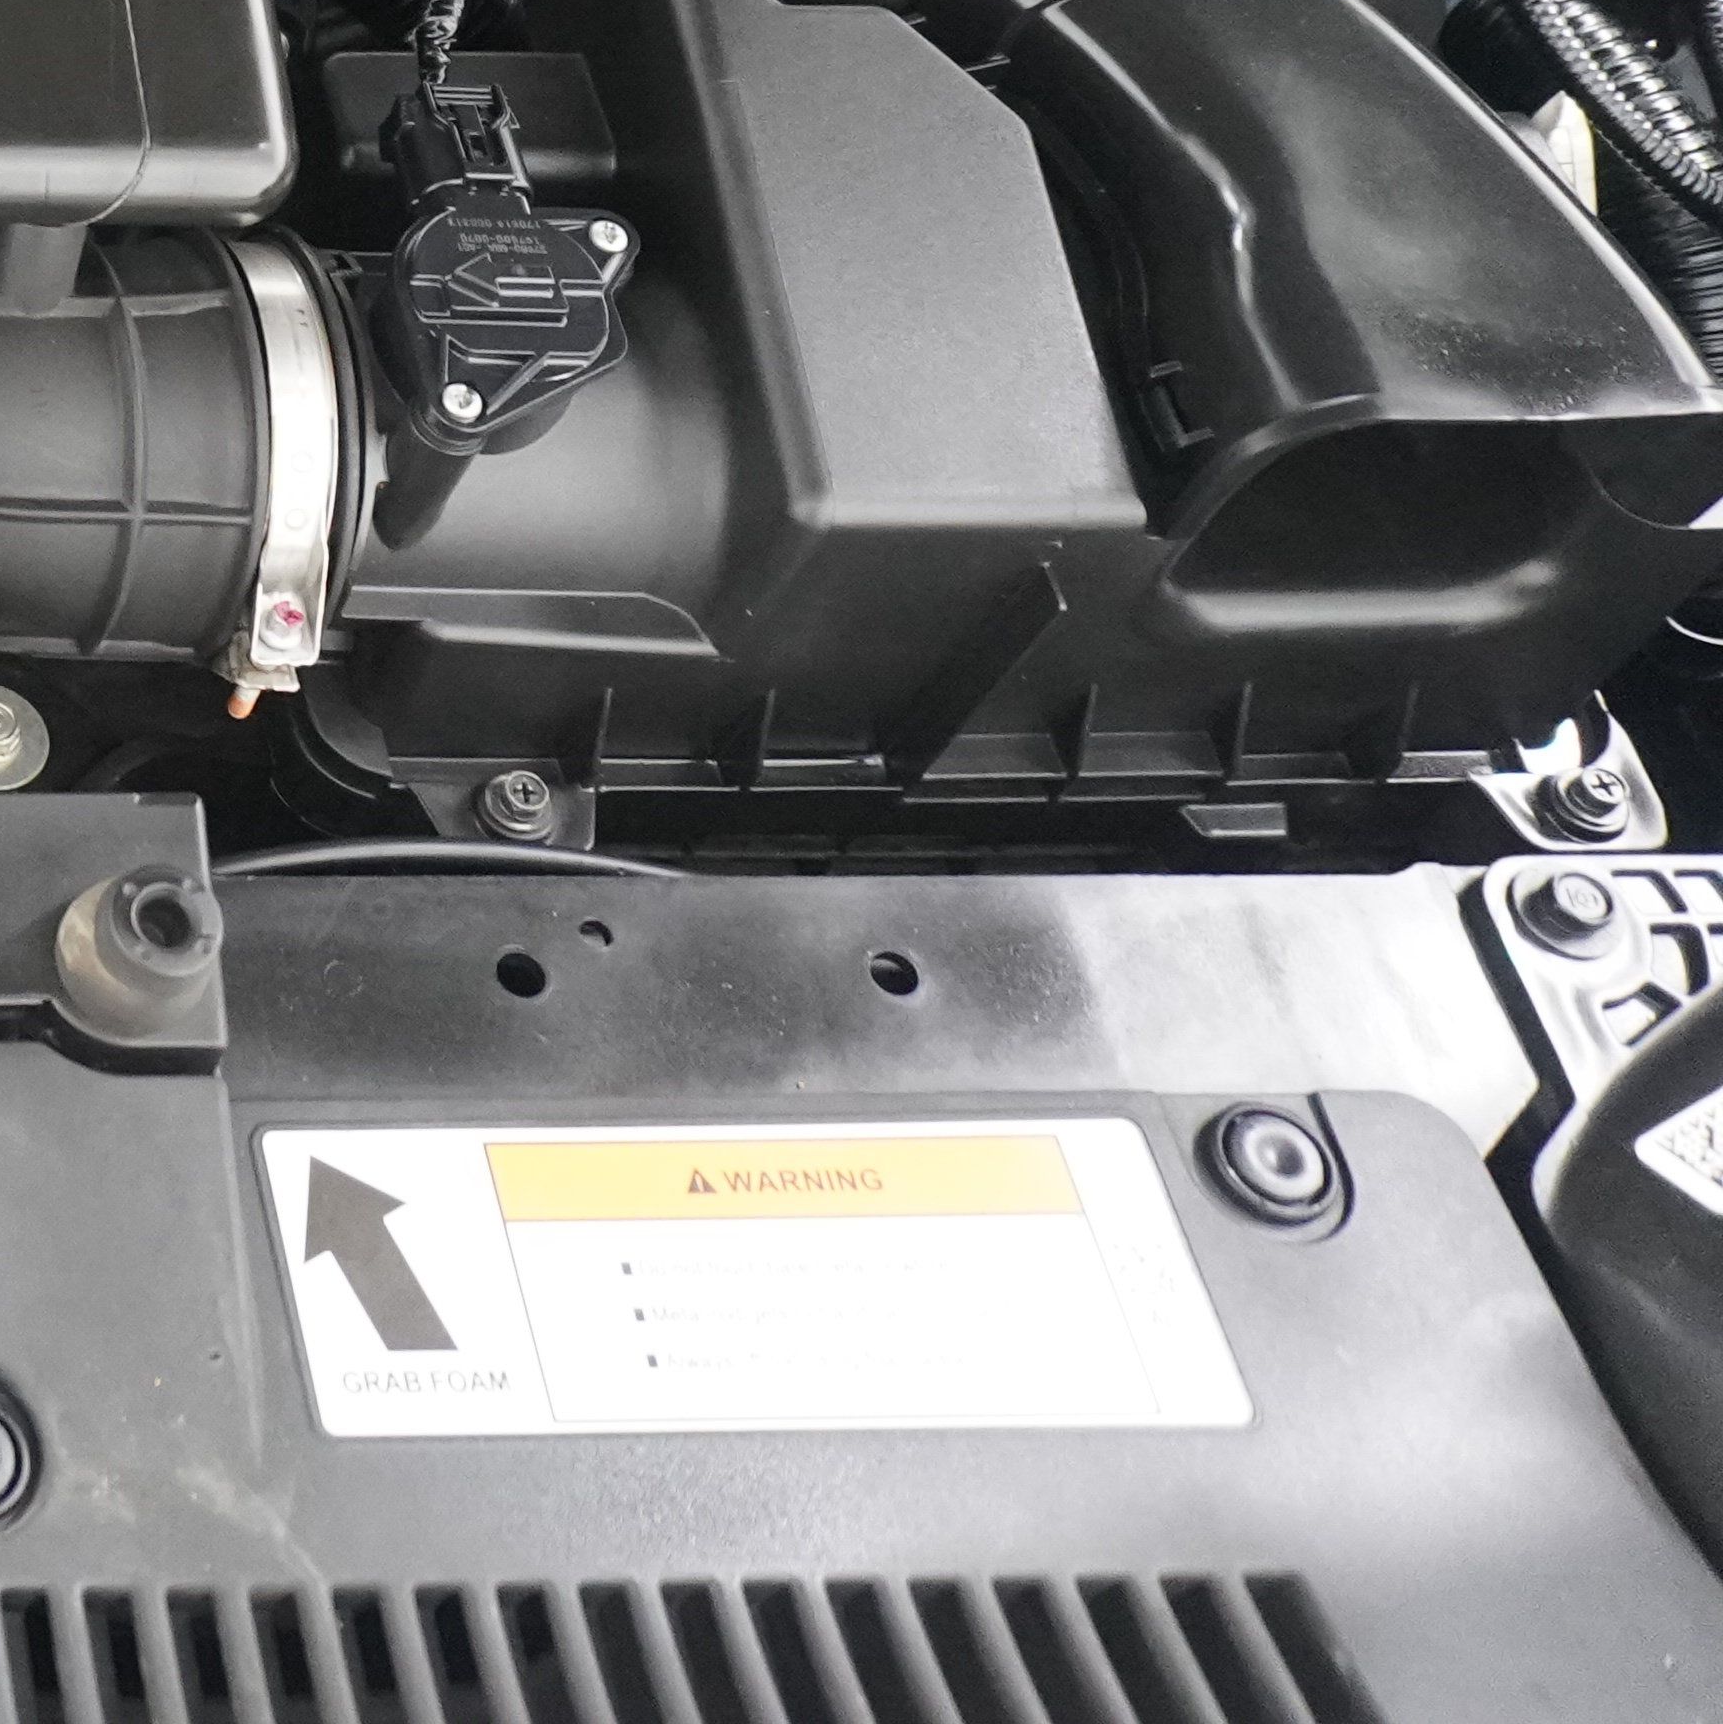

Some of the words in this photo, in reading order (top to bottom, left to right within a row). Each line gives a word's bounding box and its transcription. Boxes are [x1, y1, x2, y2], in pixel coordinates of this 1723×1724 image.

[723, 1169, 883, 1192] WARNING
[342, 1371, 421, 1393] GRAB
[430, 1371, 511, 1392] FOAM
